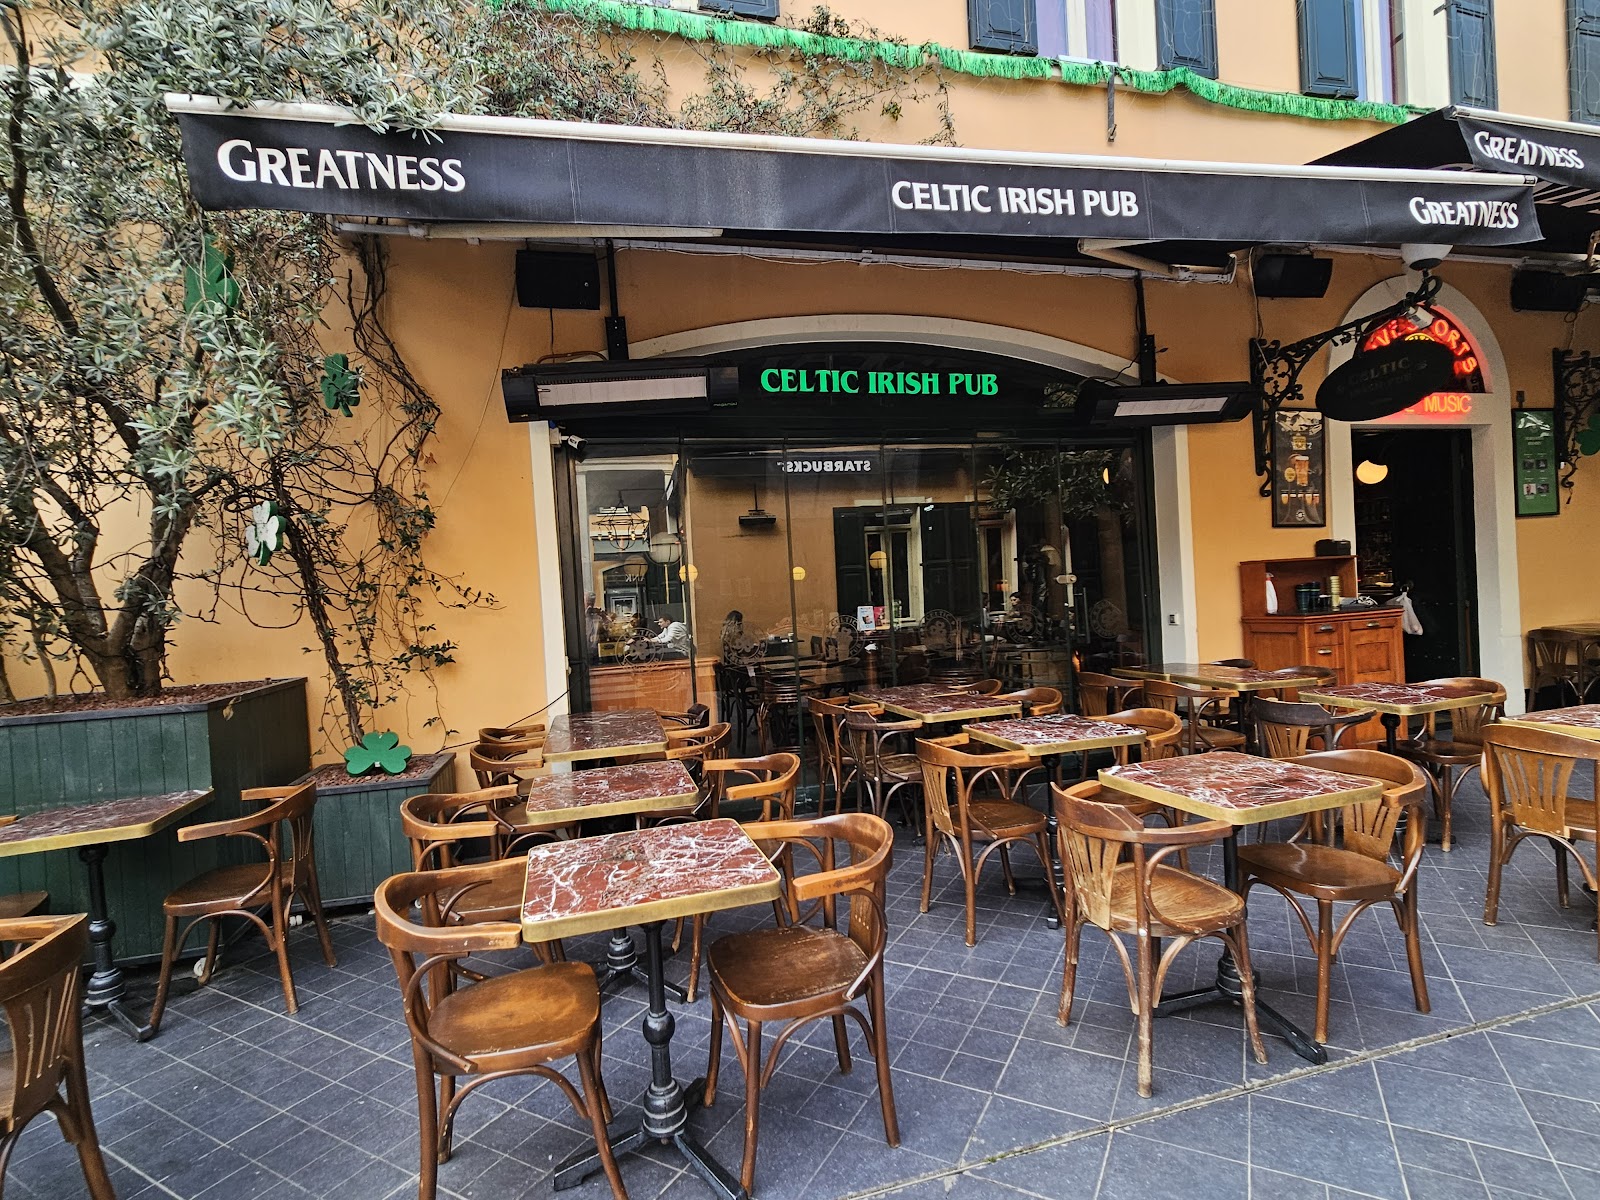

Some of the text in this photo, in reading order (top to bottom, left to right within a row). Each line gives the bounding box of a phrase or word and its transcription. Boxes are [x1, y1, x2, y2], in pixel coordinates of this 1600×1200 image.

[217, 139, 466, 193] GREATNESS
[1474, 131, 1585, 171] GREATNESS
[891, 180, 1139, 218] CELTIC IRISH PUB
[1409, 196, 1520, 229] GREATNESS
[760, 367, 999, 397] CELTIC IRISH PUB
[1423, 394, 1473, 413] MUSIC
